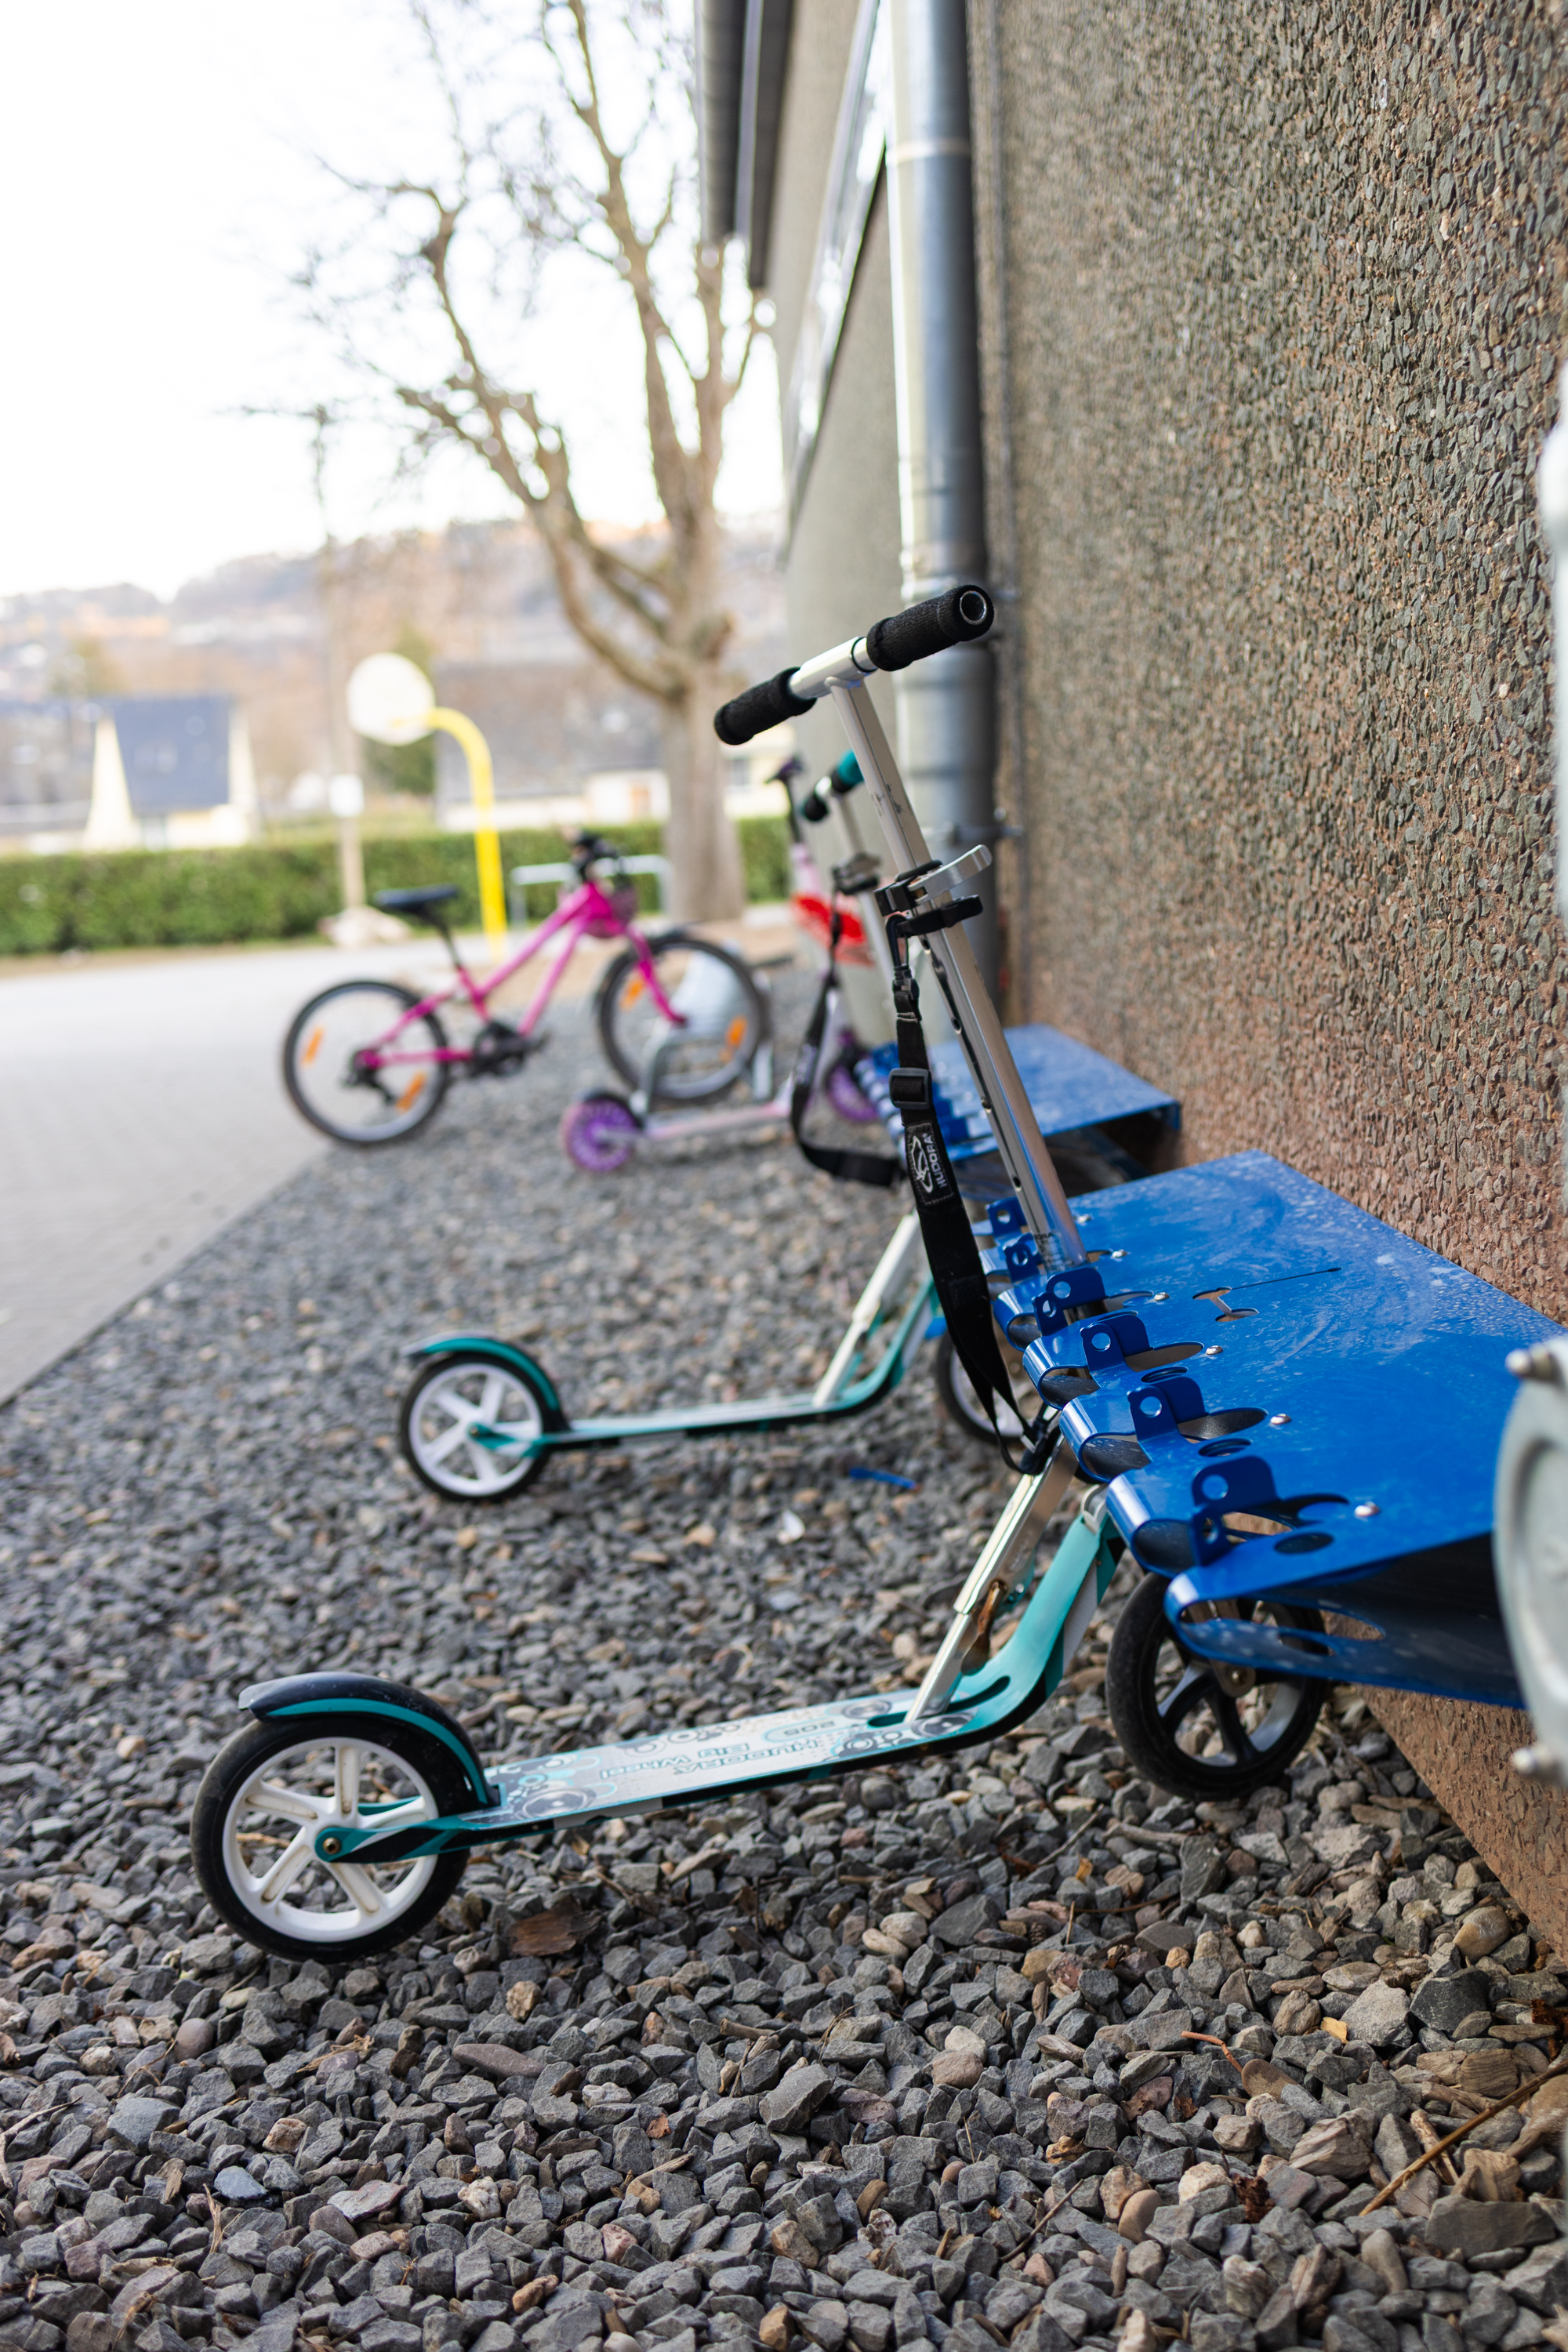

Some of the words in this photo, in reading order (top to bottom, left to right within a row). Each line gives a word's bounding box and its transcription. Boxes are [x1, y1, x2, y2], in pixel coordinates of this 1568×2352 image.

[923, 1134, 947, 1188] HUDORA
[783, 1721, 837, 1737] 205
[674, 1740, 819, 1774] HUDORA
[697, 1743, 750, 1759] Big
[600, 1755, 691, 1779] Wheel
